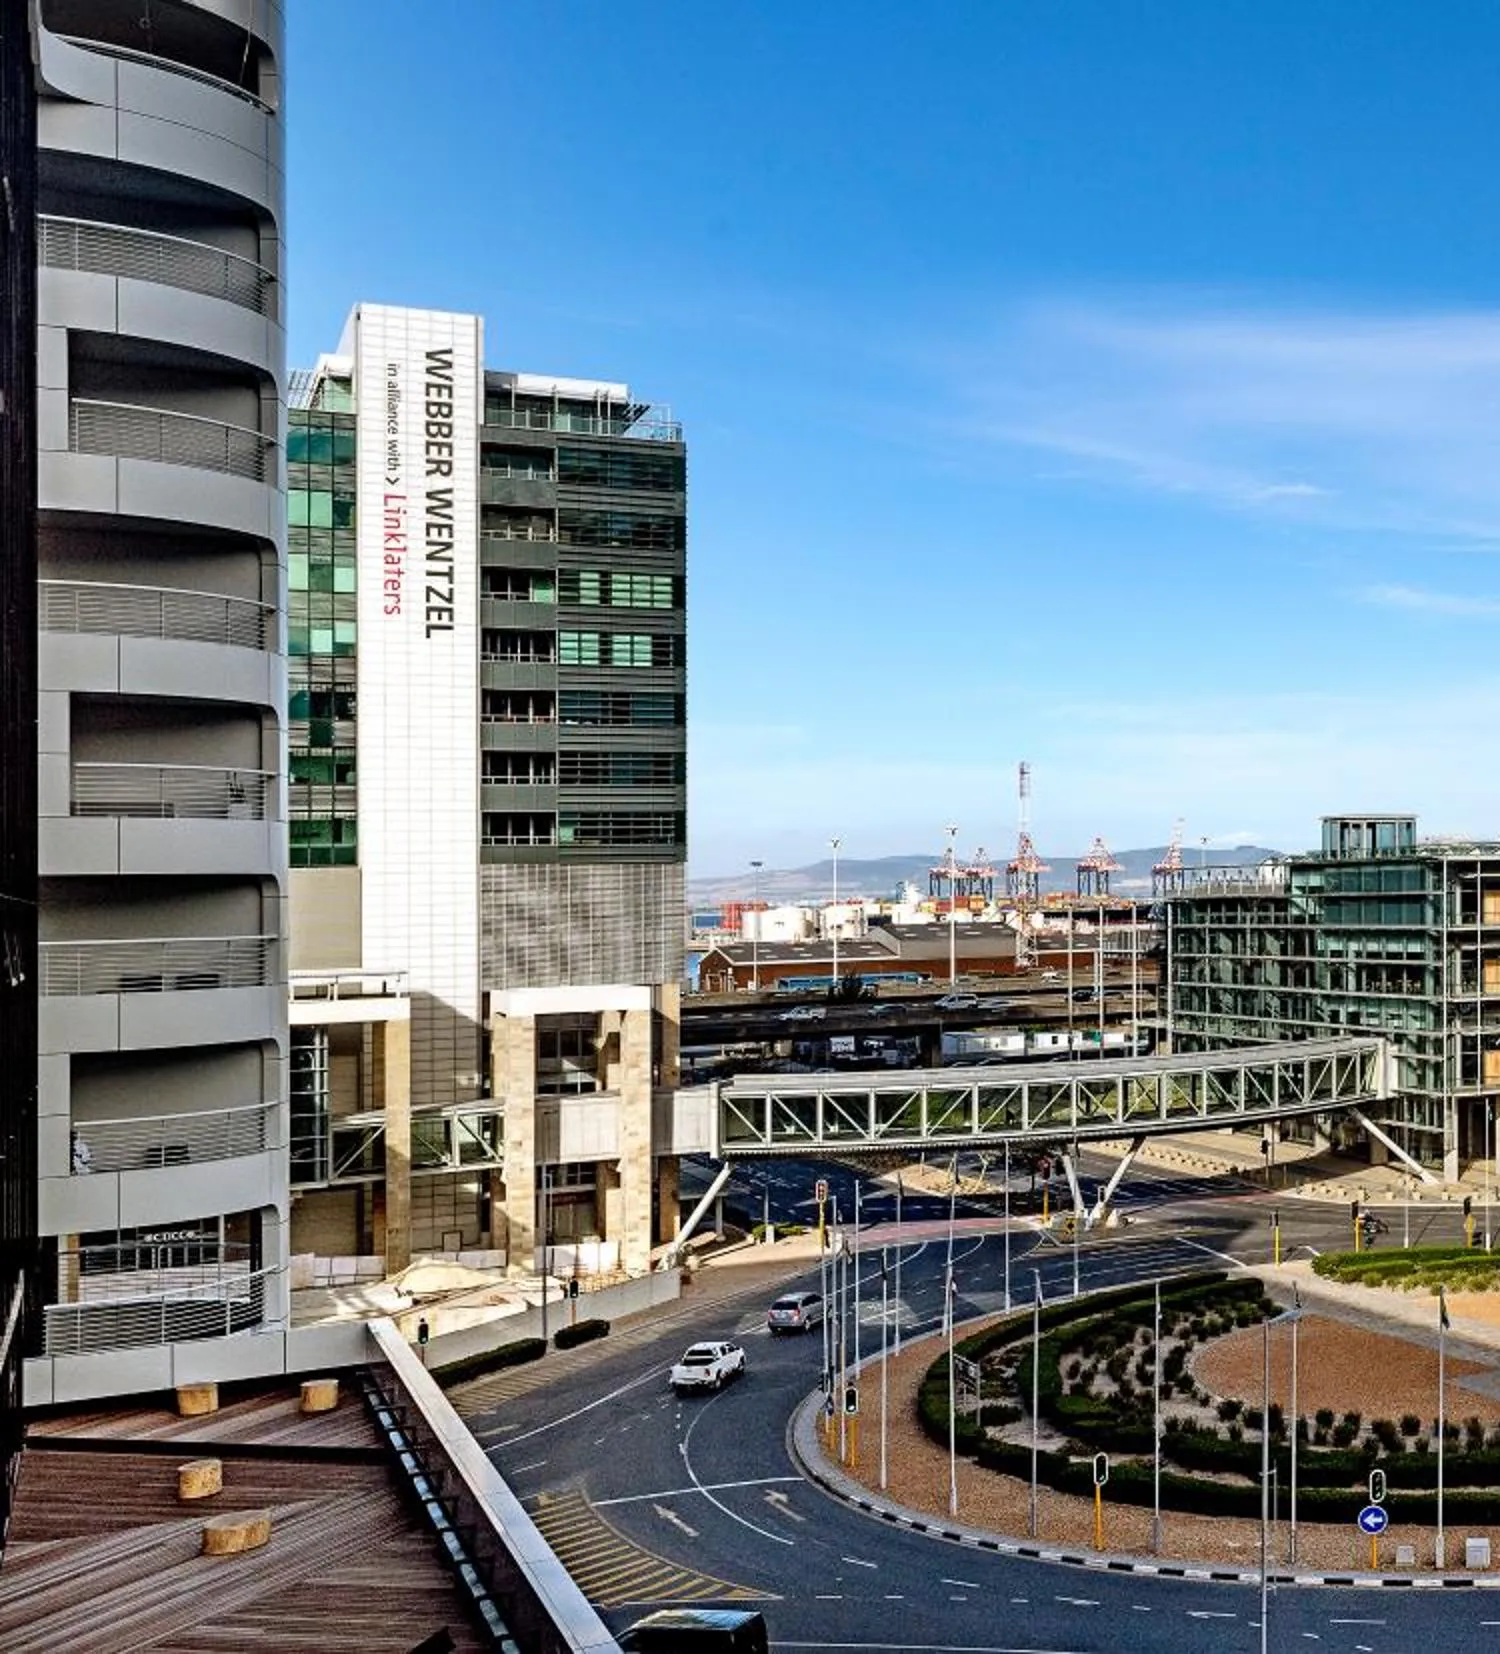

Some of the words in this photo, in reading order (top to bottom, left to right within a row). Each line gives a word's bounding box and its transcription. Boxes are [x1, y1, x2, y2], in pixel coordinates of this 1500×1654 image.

[387, 363, 400, 377] in
[387, 382, 401, 434] alliance
[425, 348, 453, 476] WEBBER
[387, 436, 401, 471] with
[383, 494, 407, 615] Linklaters
[425, 488, 454, 638] WENTZEL
